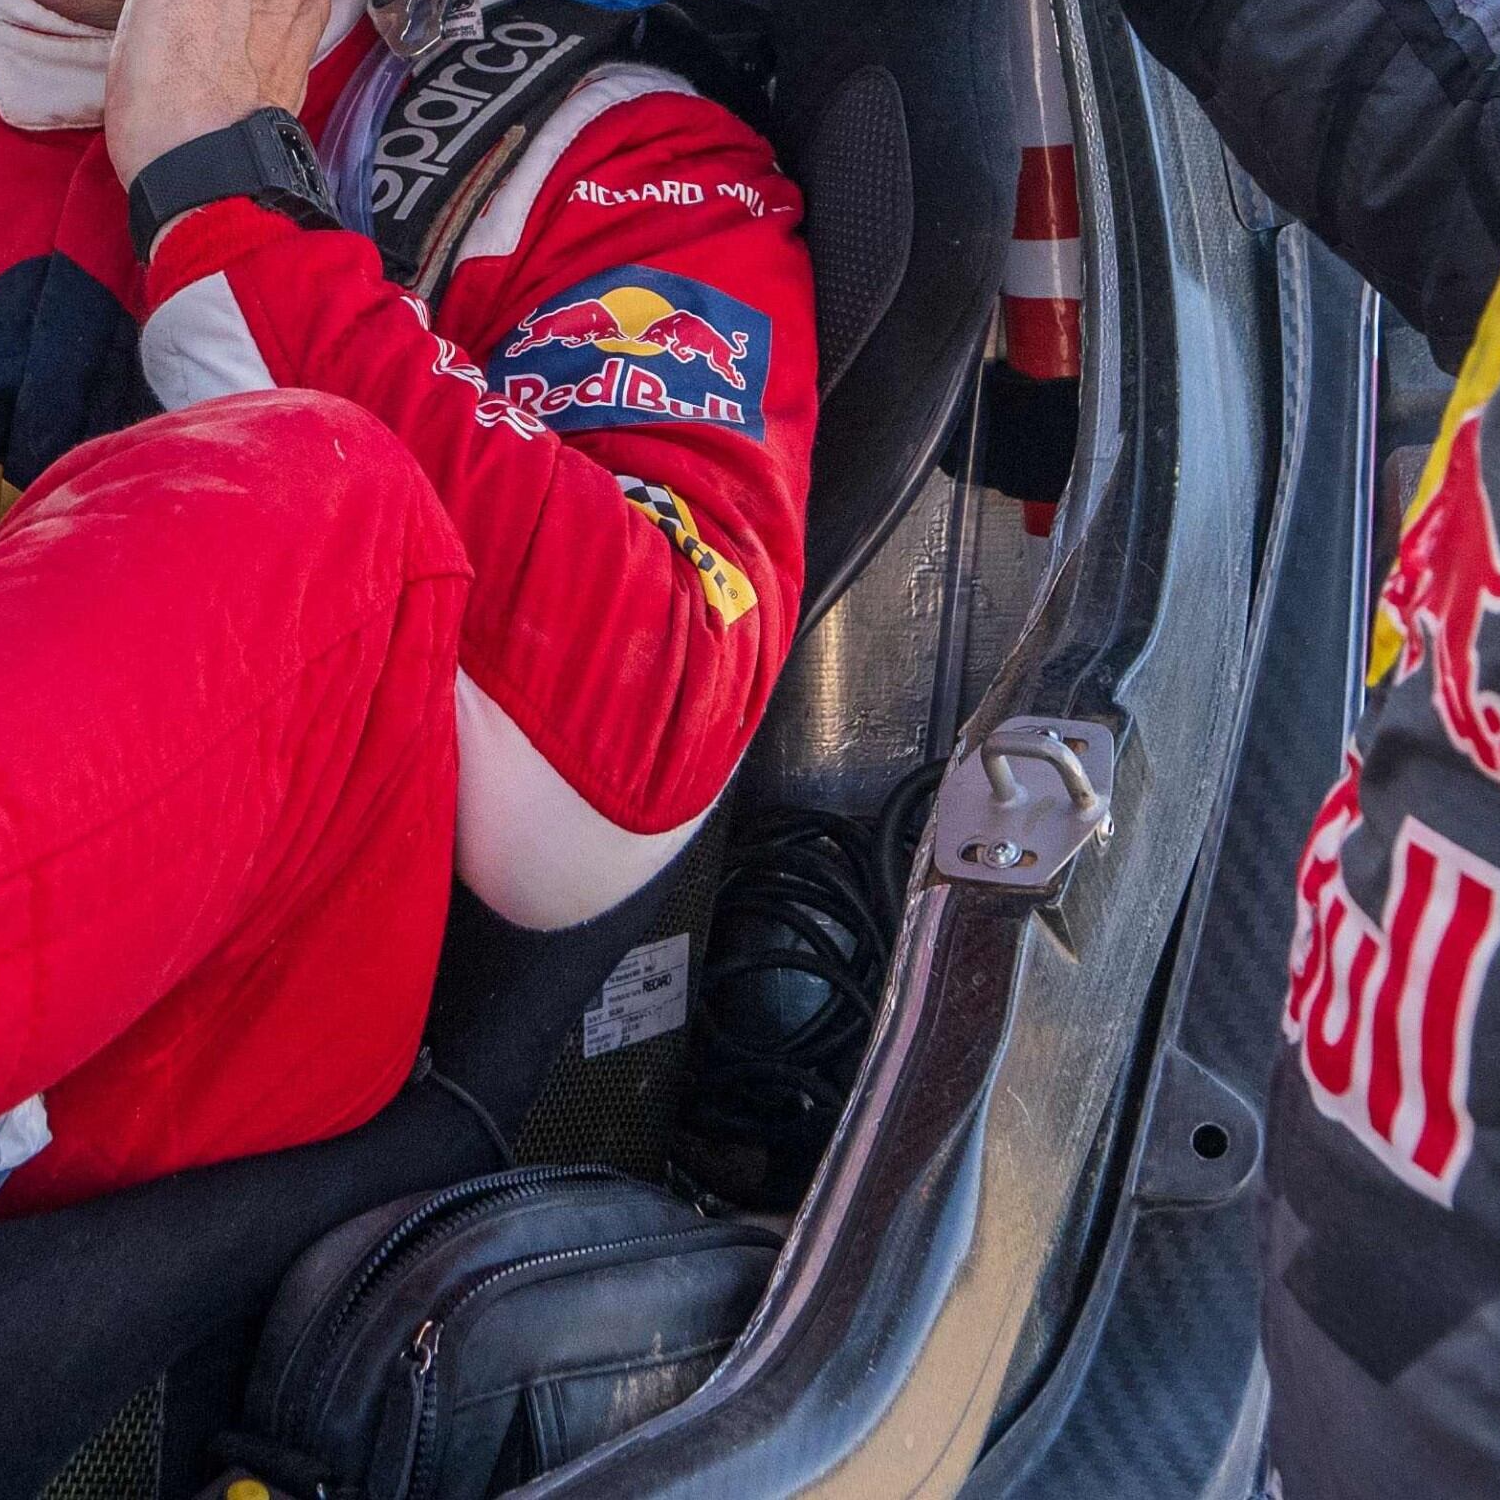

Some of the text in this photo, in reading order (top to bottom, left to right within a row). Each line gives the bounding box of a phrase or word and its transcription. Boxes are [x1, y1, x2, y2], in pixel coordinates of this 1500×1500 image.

[567, 180, 705, 207] RICHARD
[504, 357, 624, 418] Red
[621, 364, 746, 425] Bull
